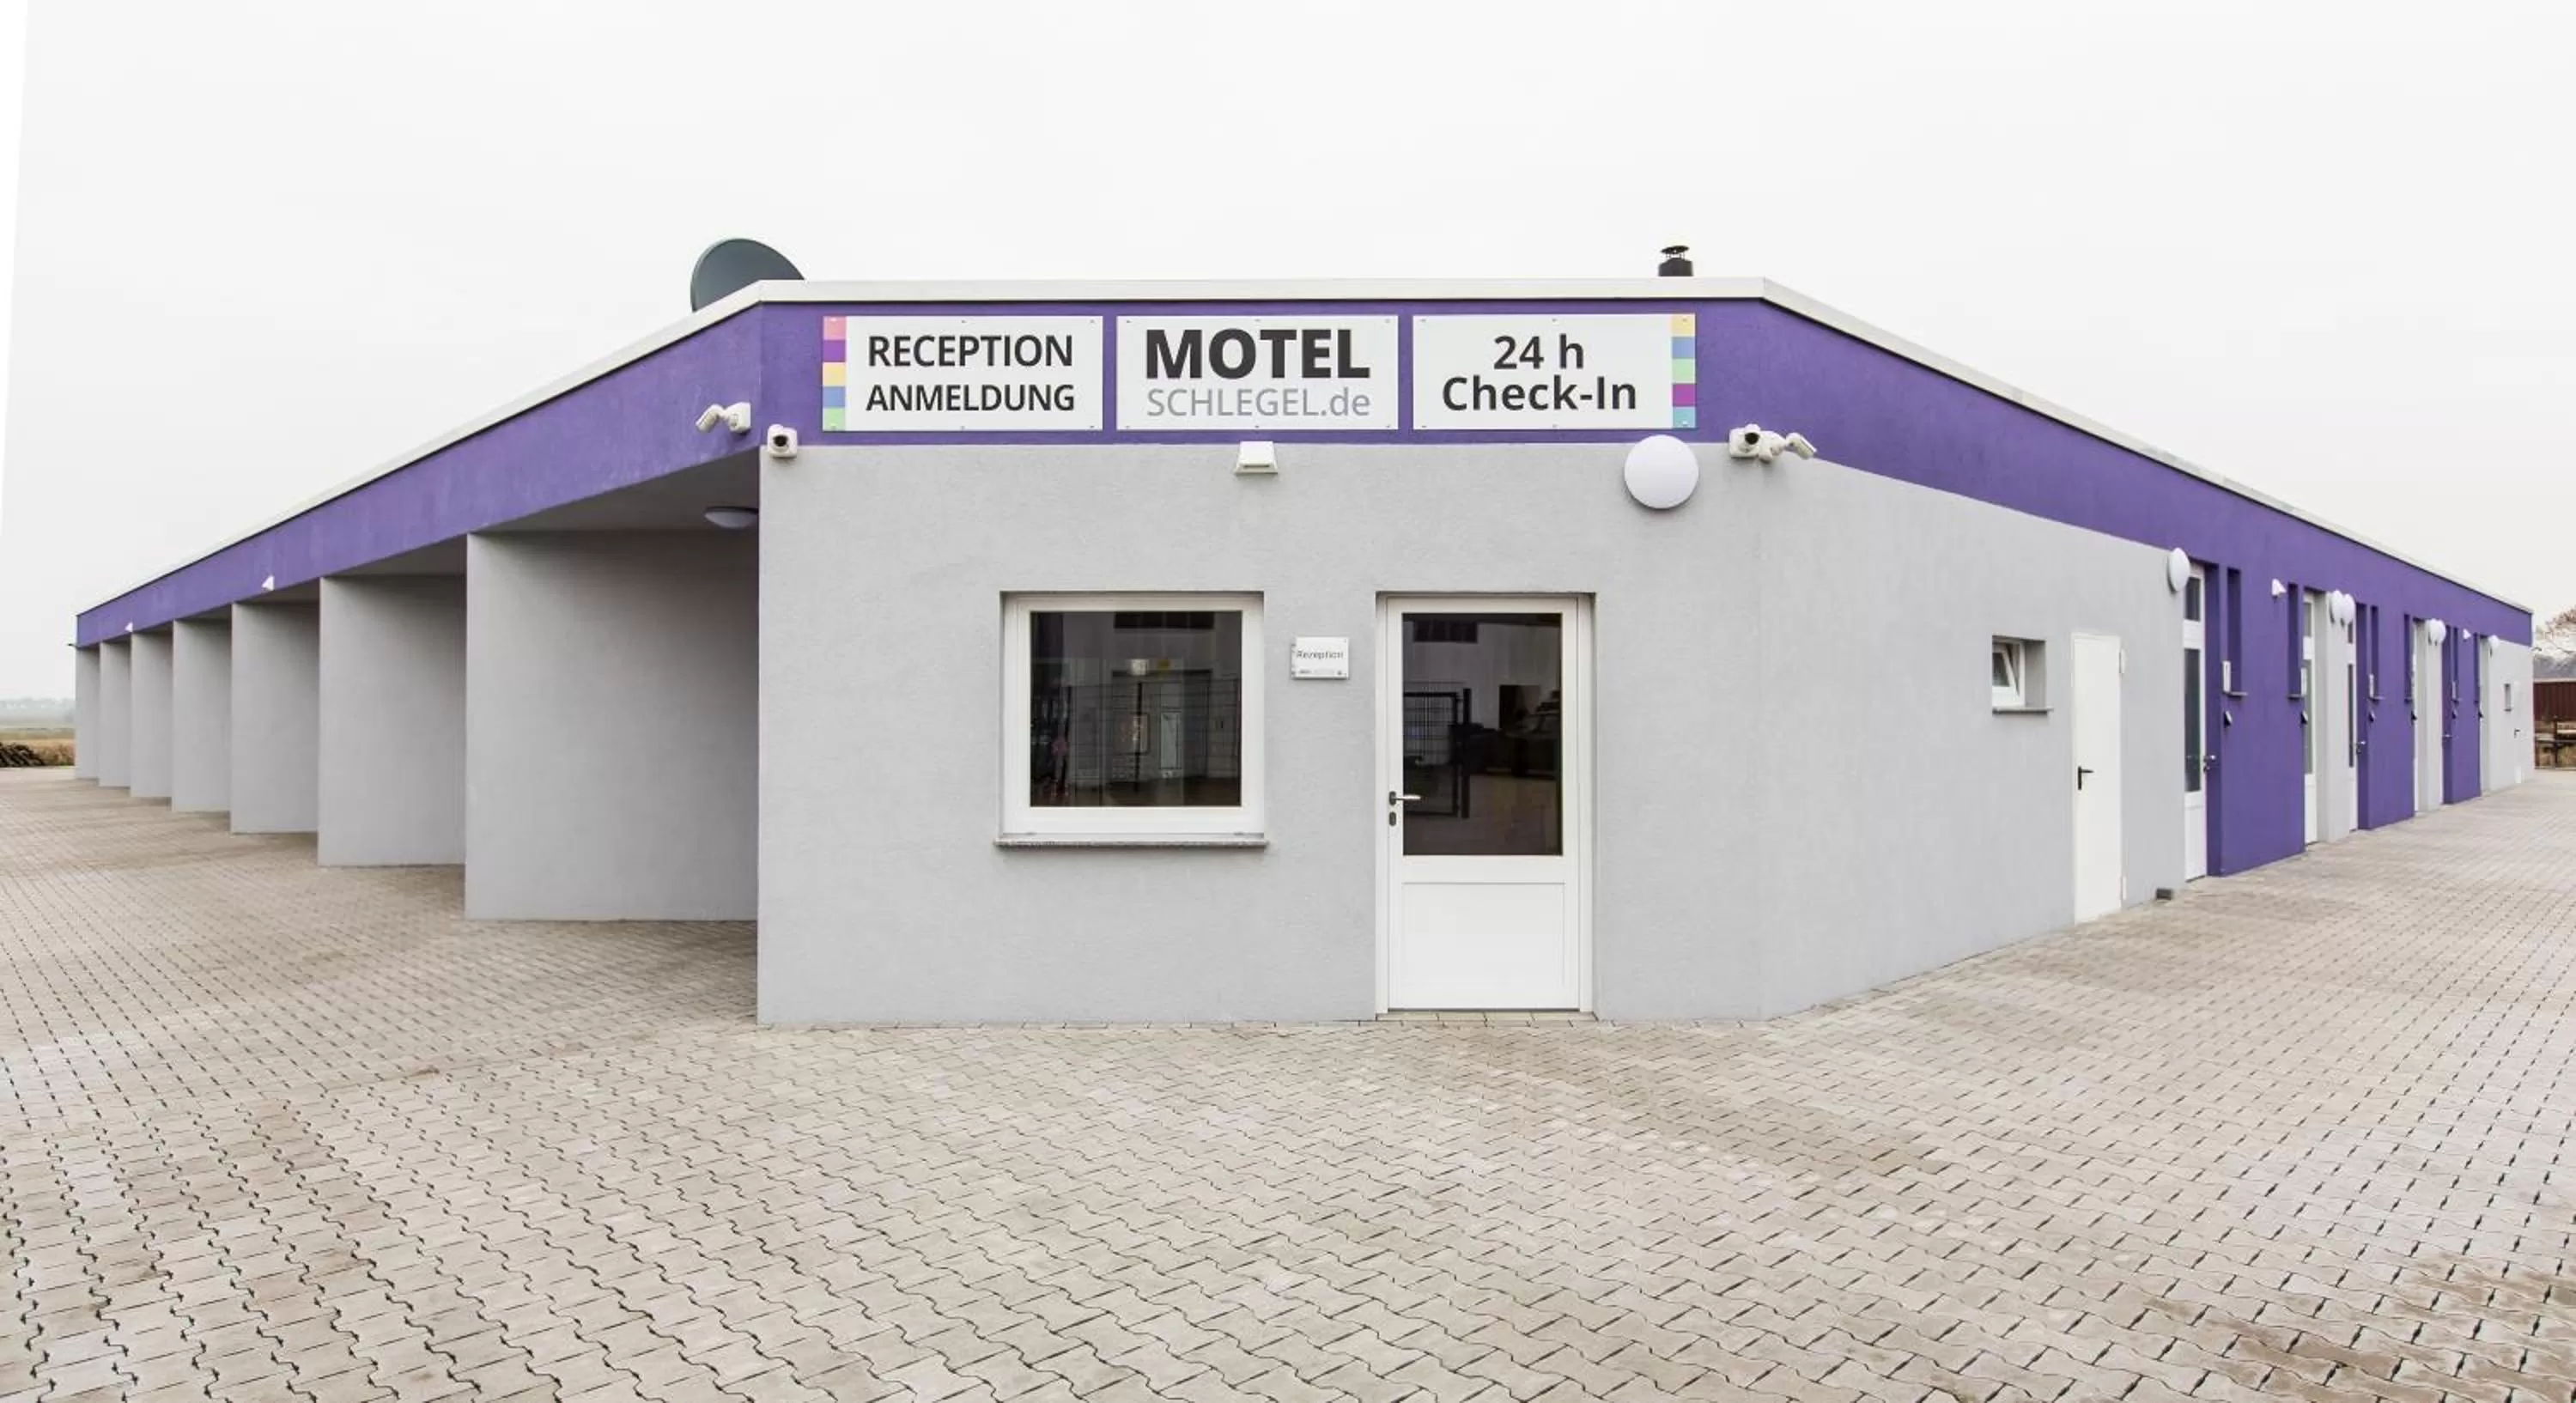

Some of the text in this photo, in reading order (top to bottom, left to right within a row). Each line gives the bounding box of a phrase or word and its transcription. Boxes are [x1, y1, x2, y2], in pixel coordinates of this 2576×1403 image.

[868, 334, 1072, 367] RECEPTION
[1145, 328, 1370, 380] MOTEL
[1493, 333, 1584, 370] 24 h
[866, 384, 1075, 411] ANMELDUNG
[1146, 386, 1371, 416] SCHLEGEL.de
[1442, 374, 1637, 411] Check-In
